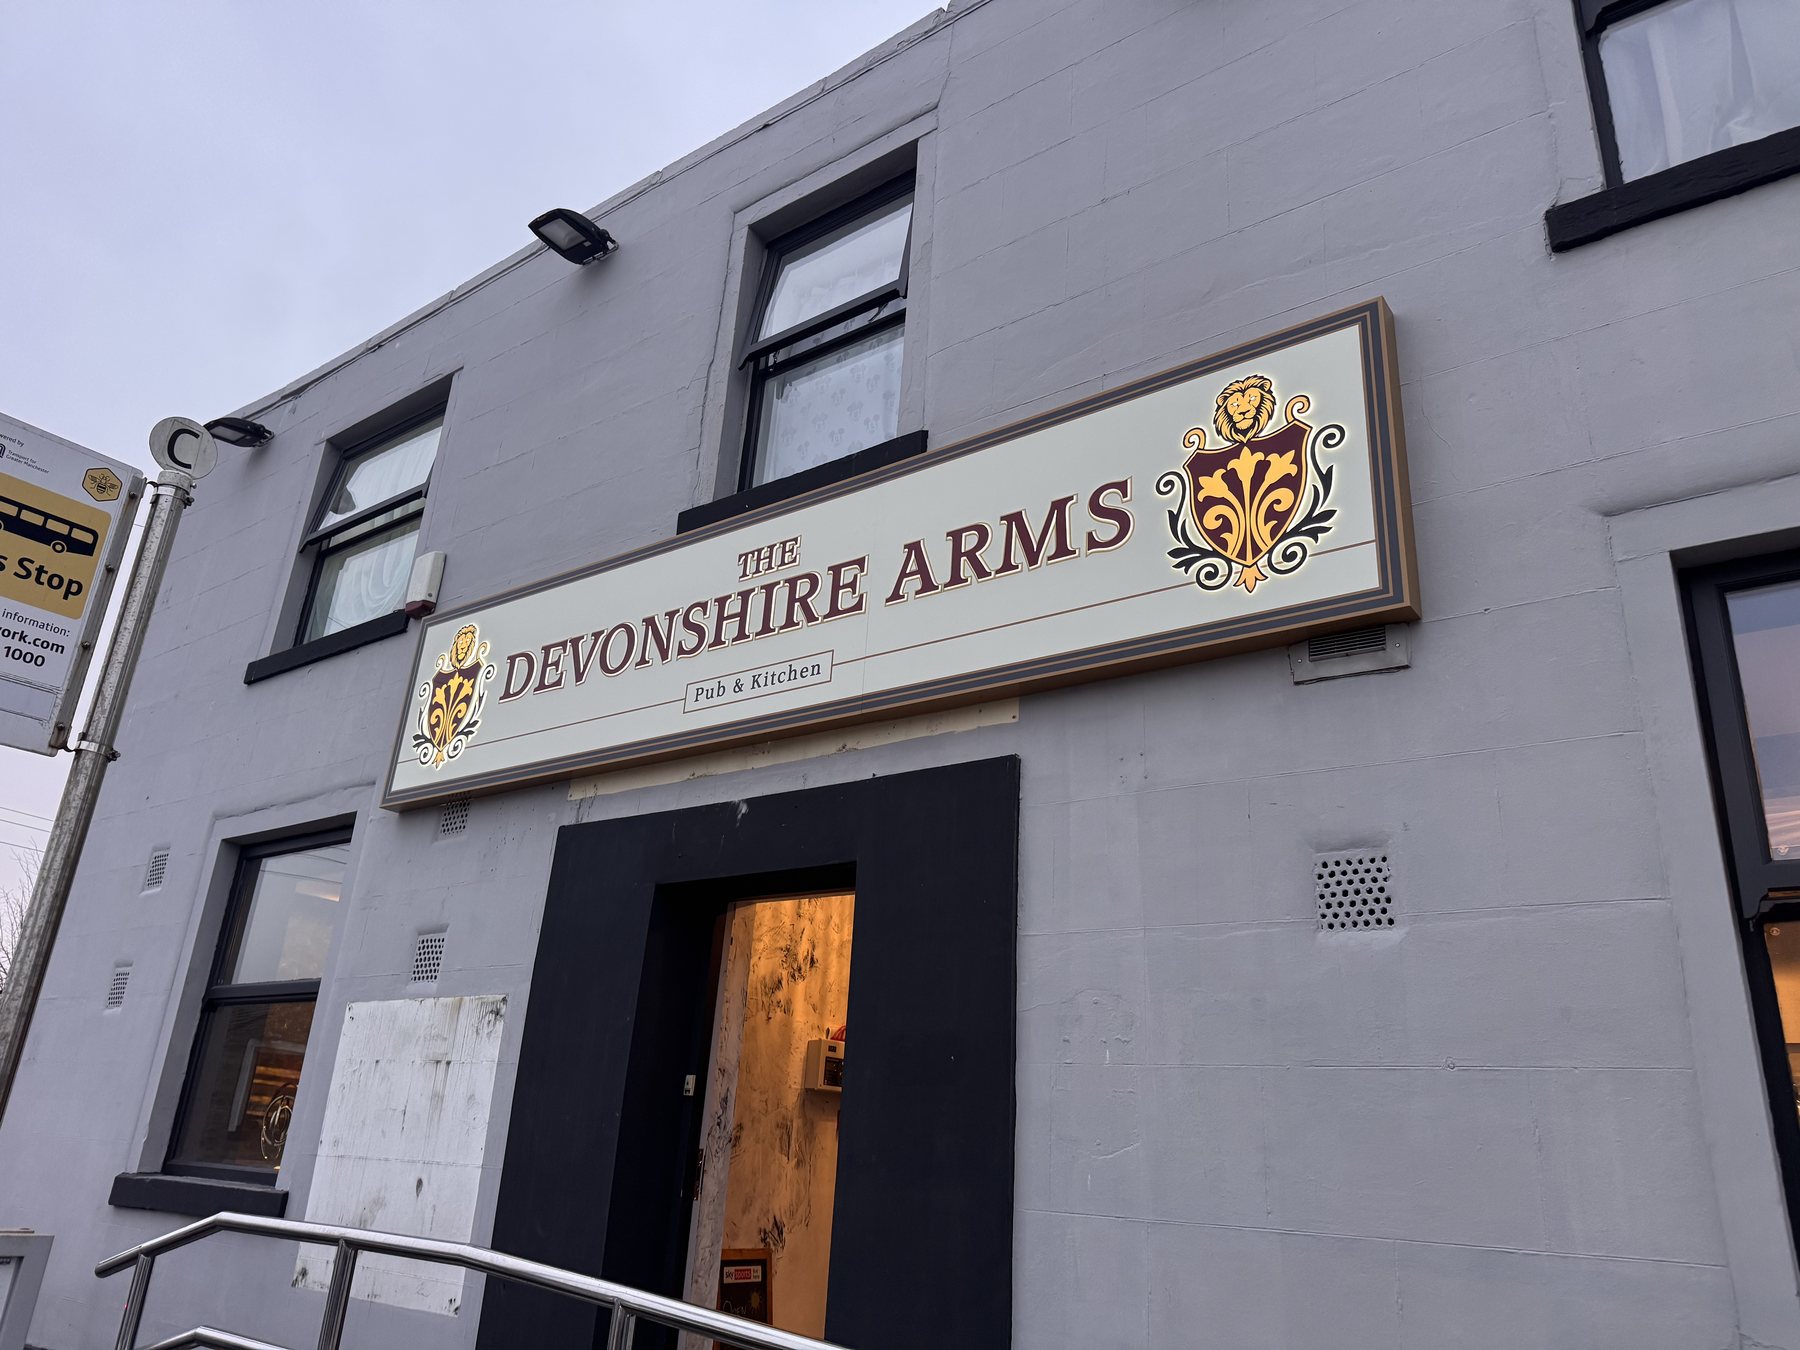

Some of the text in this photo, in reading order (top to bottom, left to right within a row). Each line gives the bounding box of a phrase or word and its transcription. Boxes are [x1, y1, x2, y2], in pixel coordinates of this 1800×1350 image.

[6, 454, 49, 473] Greater Manchester
[9, 450, 29, 460] Transport
[167, 428, 200, 469] C
[737, 535, 801, 583] THE
[13, 557, 83, 600] Stop
[498, 475, 1134, 703] DEVONSHIRE ARMS
[2, 608, 70, 637] information:
[0, 627, 65, 654] ork.com
[4, 646, 45, 667] 1000
[694, 663, 821, 702] Pub & Kitchen
